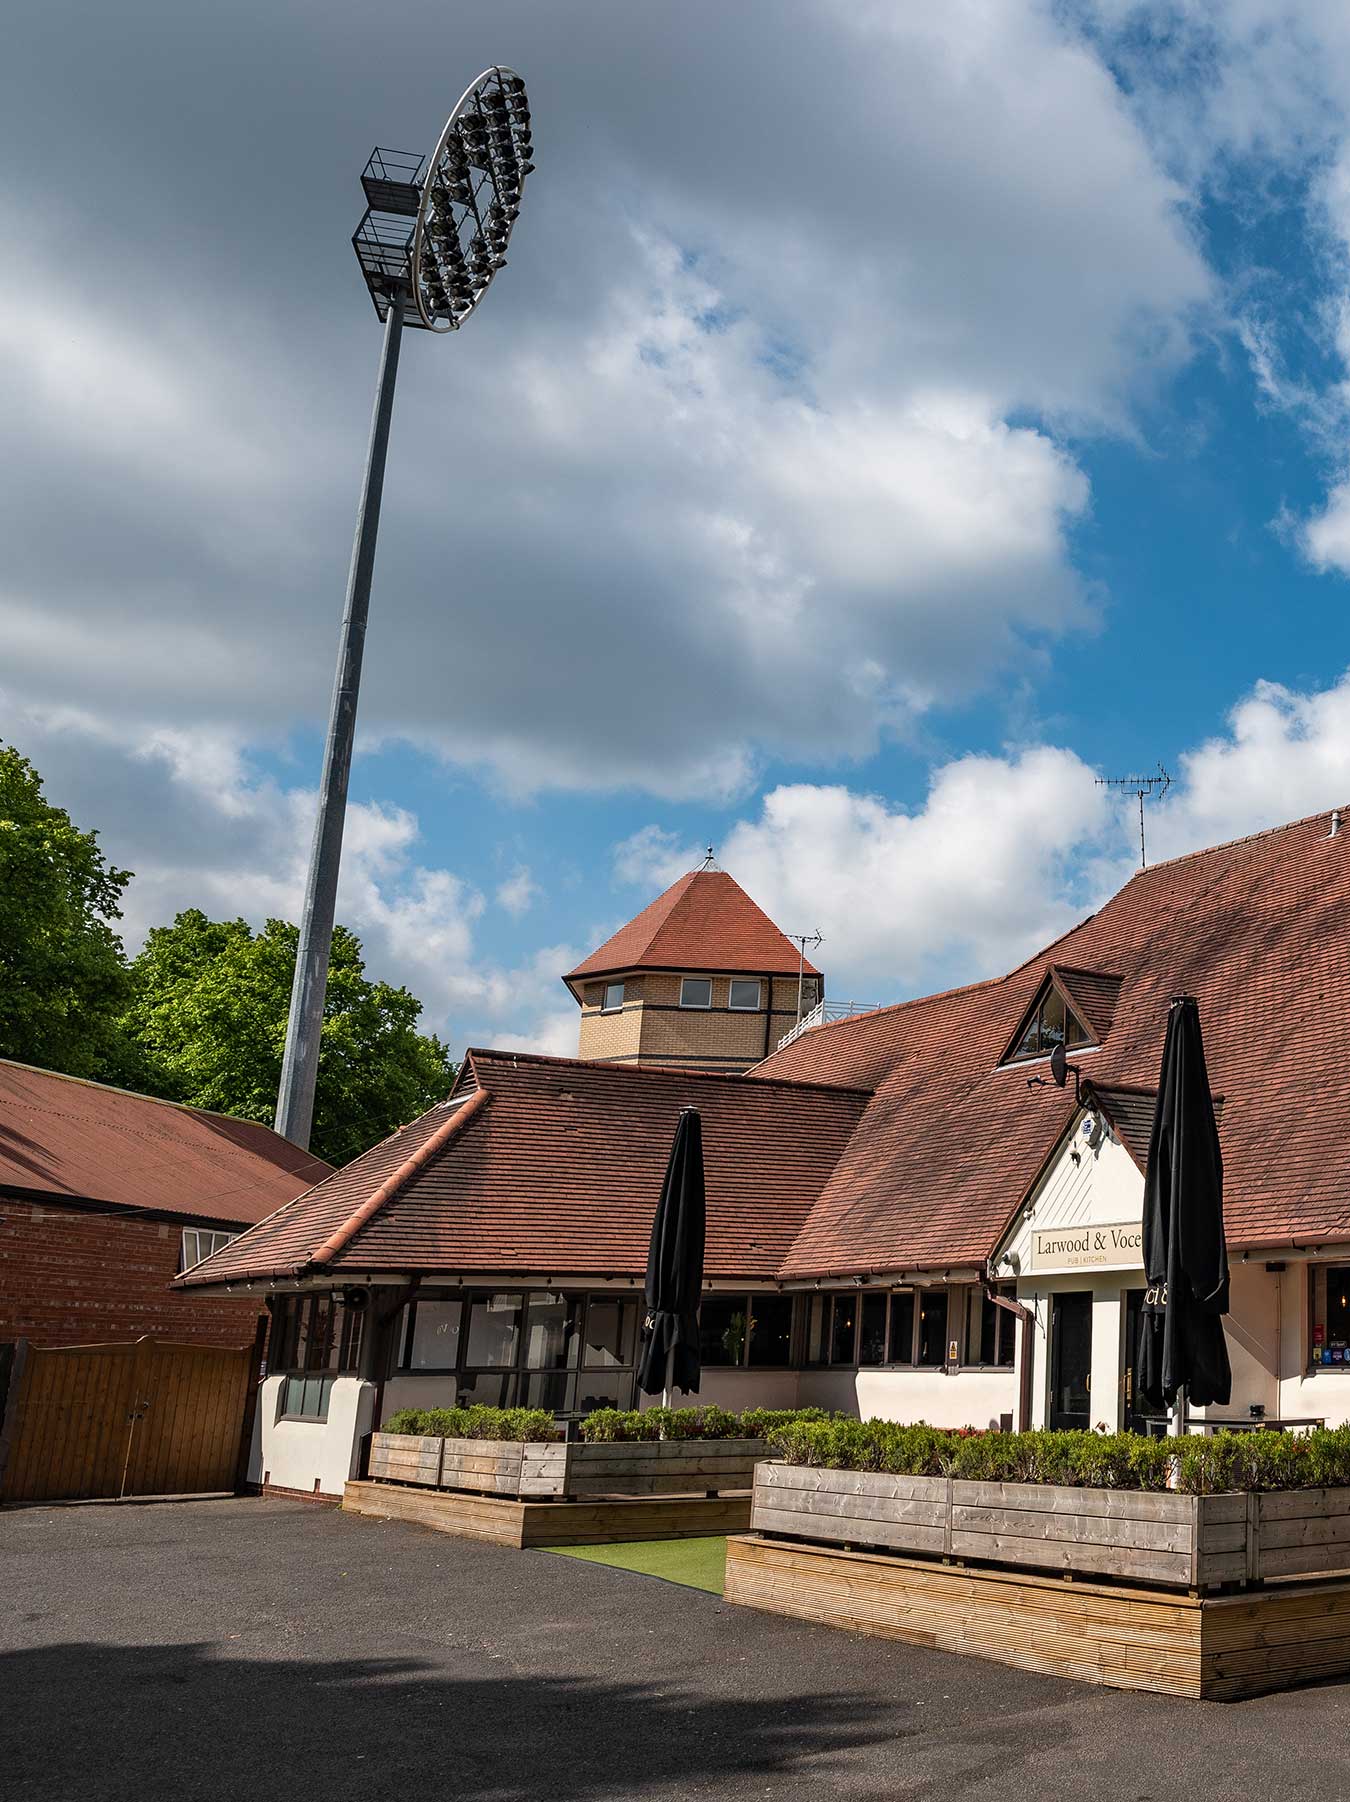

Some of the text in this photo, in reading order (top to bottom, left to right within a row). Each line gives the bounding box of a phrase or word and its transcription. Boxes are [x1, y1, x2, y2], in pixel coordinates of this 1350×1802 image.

[1038, 1229, 1141, 1254] Larwood & Voce
